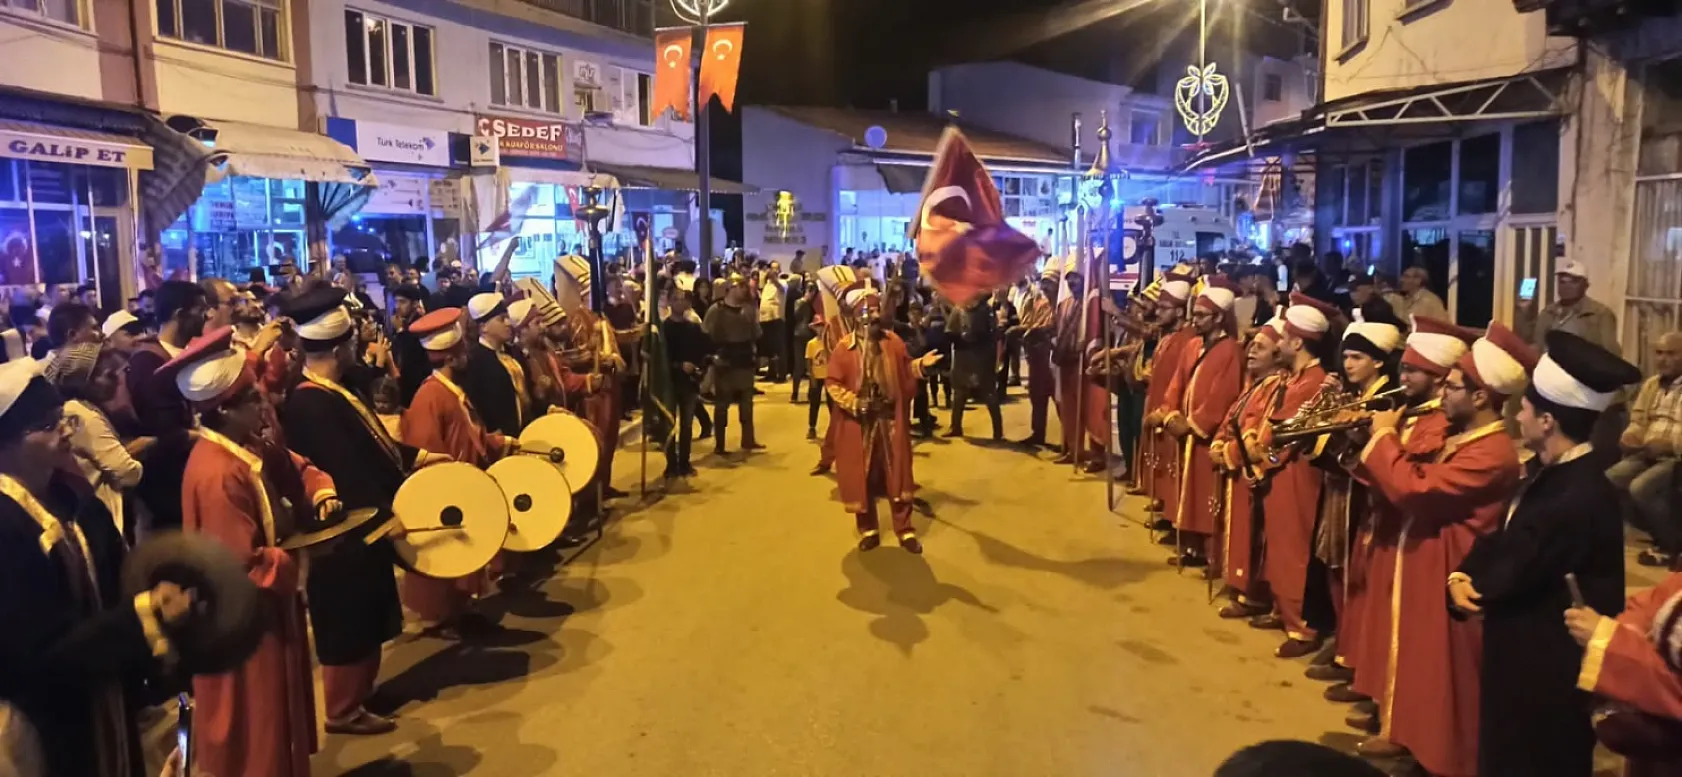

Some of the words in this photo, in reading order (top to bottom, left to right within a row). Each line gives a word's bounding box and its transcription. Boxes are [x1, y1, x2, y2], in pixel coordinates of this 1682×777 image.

[493, 119, 562, 142] SEDEF
[377, 136, 393, 147] Türk
[395, 139, 424, 151] Telekom
[96, 148, 126, 162] ET
[1169, 249, 1185, 262] 112
